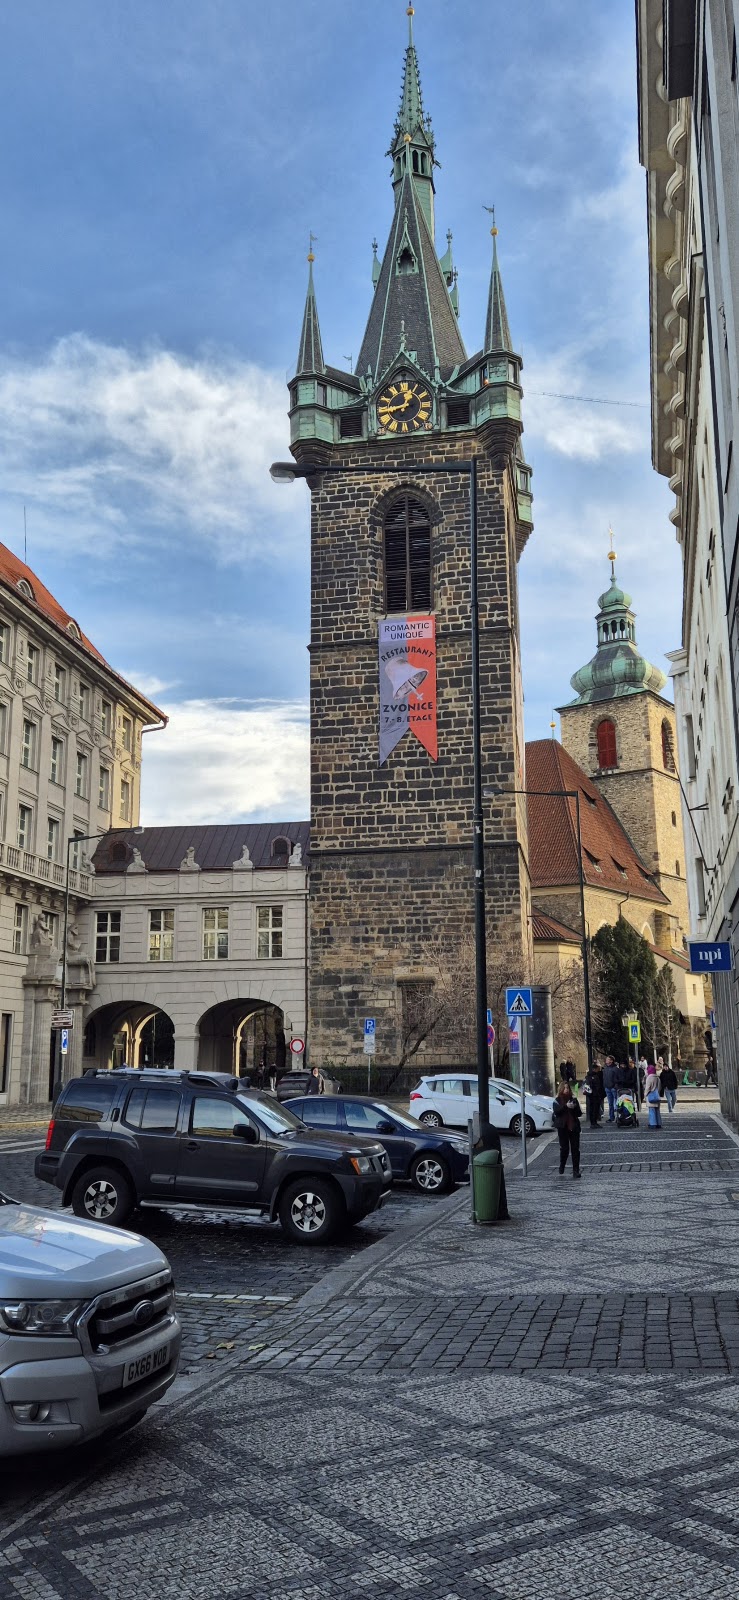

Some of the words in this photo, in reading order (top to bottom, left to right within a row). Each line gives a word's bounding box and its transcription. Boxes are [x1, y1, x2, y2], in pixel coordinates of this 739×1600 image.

[384, 622, 430, 633] ROMANTIC
[390, 631, 424, 640] UNIQUE
[380, 646, 435, 662] RESTAURANT
[383, 701, 433, 713] ZVONICE
[407, 714, 432, 722] ETAGE
[698, 948, 722, 965] npi
[366, 1020, 374, 1030] P
[127, 1354, 152, 1382] GX66
